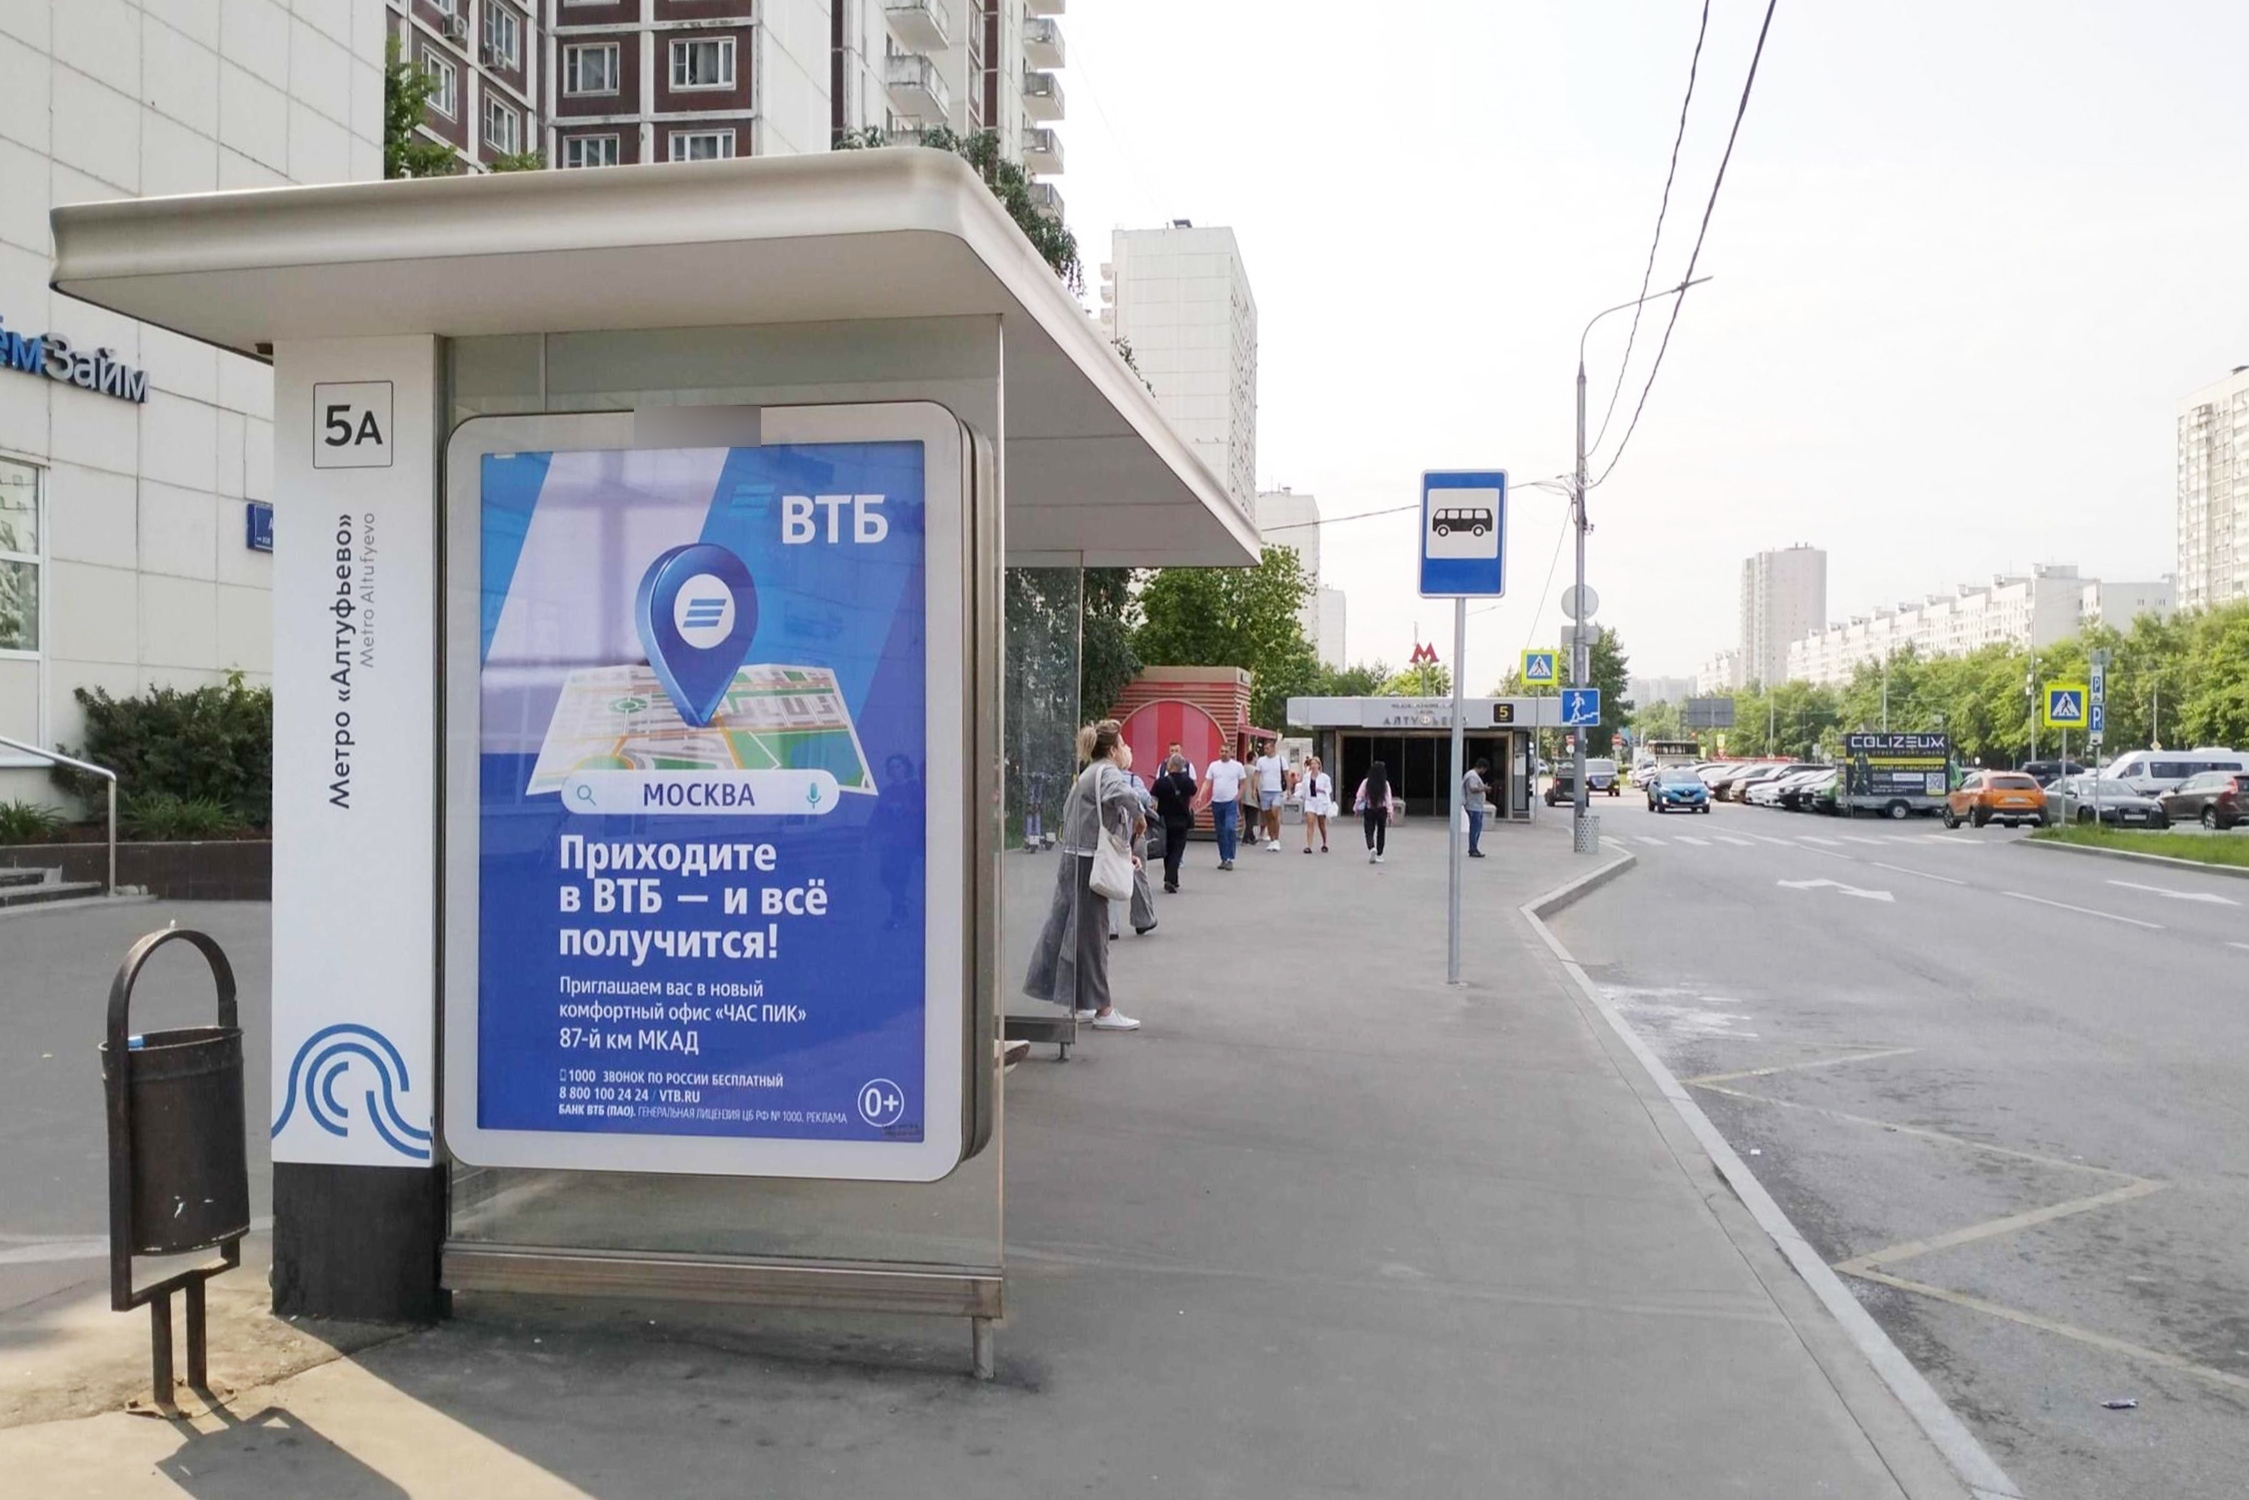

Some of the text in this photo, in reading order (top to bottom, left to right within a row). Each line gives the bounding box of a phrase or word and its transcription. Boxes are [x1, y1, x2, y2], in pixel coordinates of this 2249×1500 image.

[325, 404, 383, 446] 5А
[782, 494, 888, 544] ВТБ
[359, 513, 377, 668] Metro Altufyevo
[329, 514, 356, 809] Метро «Алтуфьево»
[1499, 706, 1509, 717] 5
[2092, 707, 2101, 729] P
[643, 783, 755, 807] МОСКВА
[560, 834, 777, 879] Приходите
[560, 885, 581, 912] в
[593, 878, 663, 913] ВТБ
[724, 887, 747, 914] и
[761, 878, 828, 915] всё
[559, 923, 778, 967] получится!
[560, 976, 763, 998] Приглашаем вас в новый
[560, 1000, 807, 1024] комфортный офис «ЧАС ПИК»
[560, 1027, 699, 1055] 87-й км МКАД
[568, 1069, 784, 1087] 1000 ЗВОНОК ПО РОССИИ БЕСПЛАТНЫЙ
[559, 1086, 567, 1099] 8
[569, 1086, 591, 1100] 800
[594, 1087, 615, 1100] 100
[617, 1088, 632, 1101] 24
[634, 1088, 649, 1101] 24
[659, 1089, 700, 1103] VTB.RU
[865, 1088, 899, 1117] 0+
[558, 1104, 585, 1115] БАНК
[586, 1105, 605, 1116] ВТБ
[607, 1105, 636, 1118] (ПАО).
[638, 1106, 695, 1119] ГЕНЕРАЛЬНАЯ
[696, 1108, 741, 1120] ЛИЦЕНЗИЯ
[742, 1110, 754, 1122] ЦБ
[756, 1110, 769, 1121] РФ
[806, 1112, 848, 1124] РЕКЛАМА
